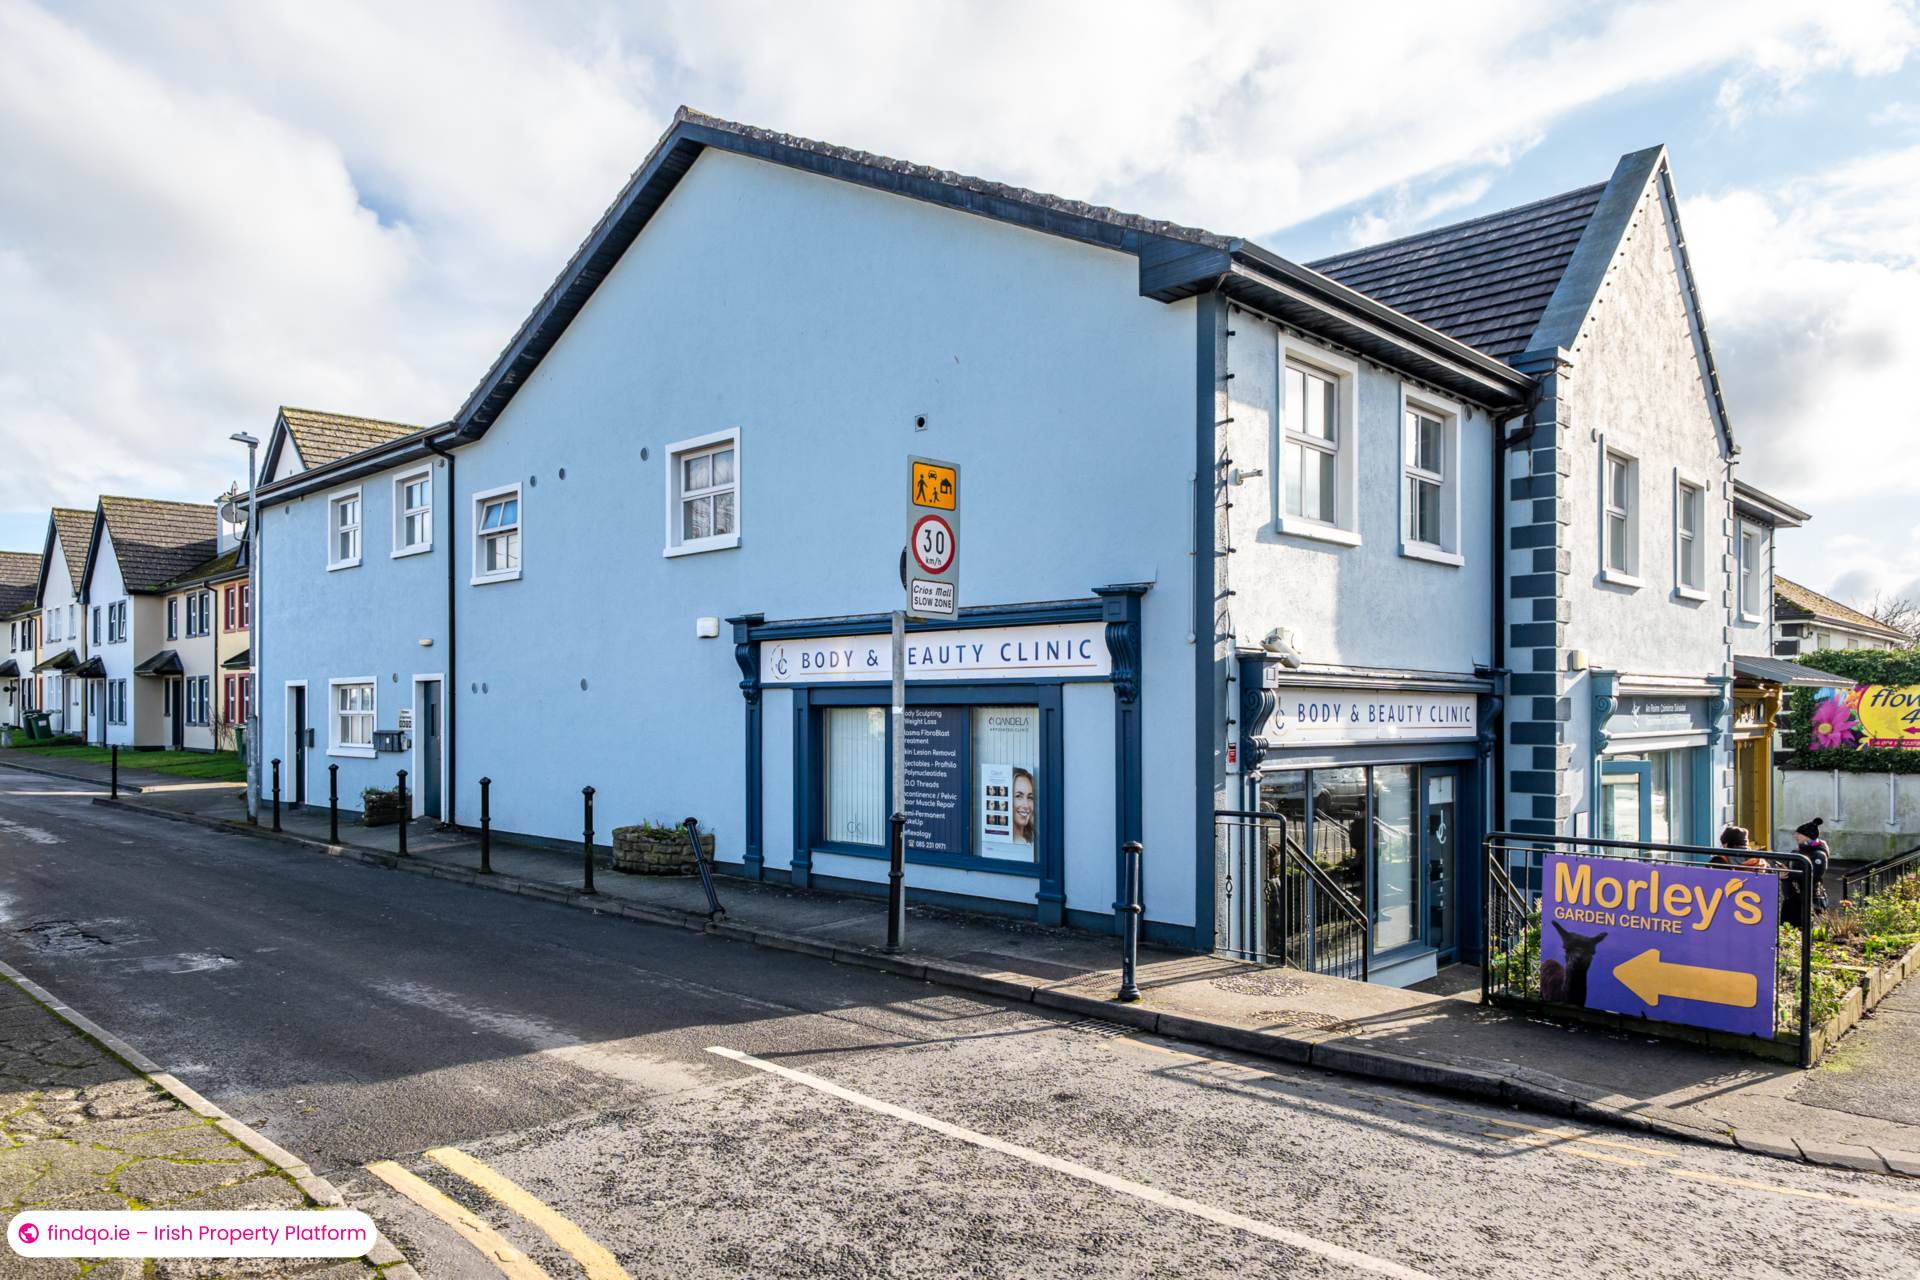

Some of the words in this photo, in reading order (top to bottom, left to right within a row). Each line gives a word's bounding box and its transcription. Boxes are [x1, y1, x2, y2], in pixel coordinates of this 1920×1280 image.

[923, 529, 945, 555] 30
[925, 556, 942, 567] km/h
[913, 584, 933, 596] Crios
[935, 587, 952, 598] Mall
[914, 596, 933, 606] SLOW
[934, 598, 952, 609] ZONE
[802, 649, 854, 669] BODY
[866, 649, 879, 667] &
[907, 643, 984, 665] EAUTY
[1000, 638, 1092, 662] CLINIC
[904, 710, 915, 719] ody
[915, 710, 942, 719] Sculpting
[1298, 703, 1341, 723] BODY
[1350, 703, 1360, 723] &
[1369, 704, 1423, 723] BEAUTY
[1430, 705, 1471, 722] CLINIC
[921, 729, 950, 737] FibroBlast
[932, 749, 956, 757] Removal
[934, 760, 957, 769] Profhilo
[916, 780, 940, 788] Threads
[941, 792, 958, 800] Pelvic
[916, 799, 935, 807] Muscle
[936, 800, 956, 809] Repair
[904, 810, 946, 820] emi-Permanent
[906, 818, 924, 826] akeUp
[903, 829, 932, 839] eflexology
[1554, 861, 1763, 931] Morley's
[1554, 906, 1616, 926] GARDEN
[1619, 913, 1683, 934] CENTRE
